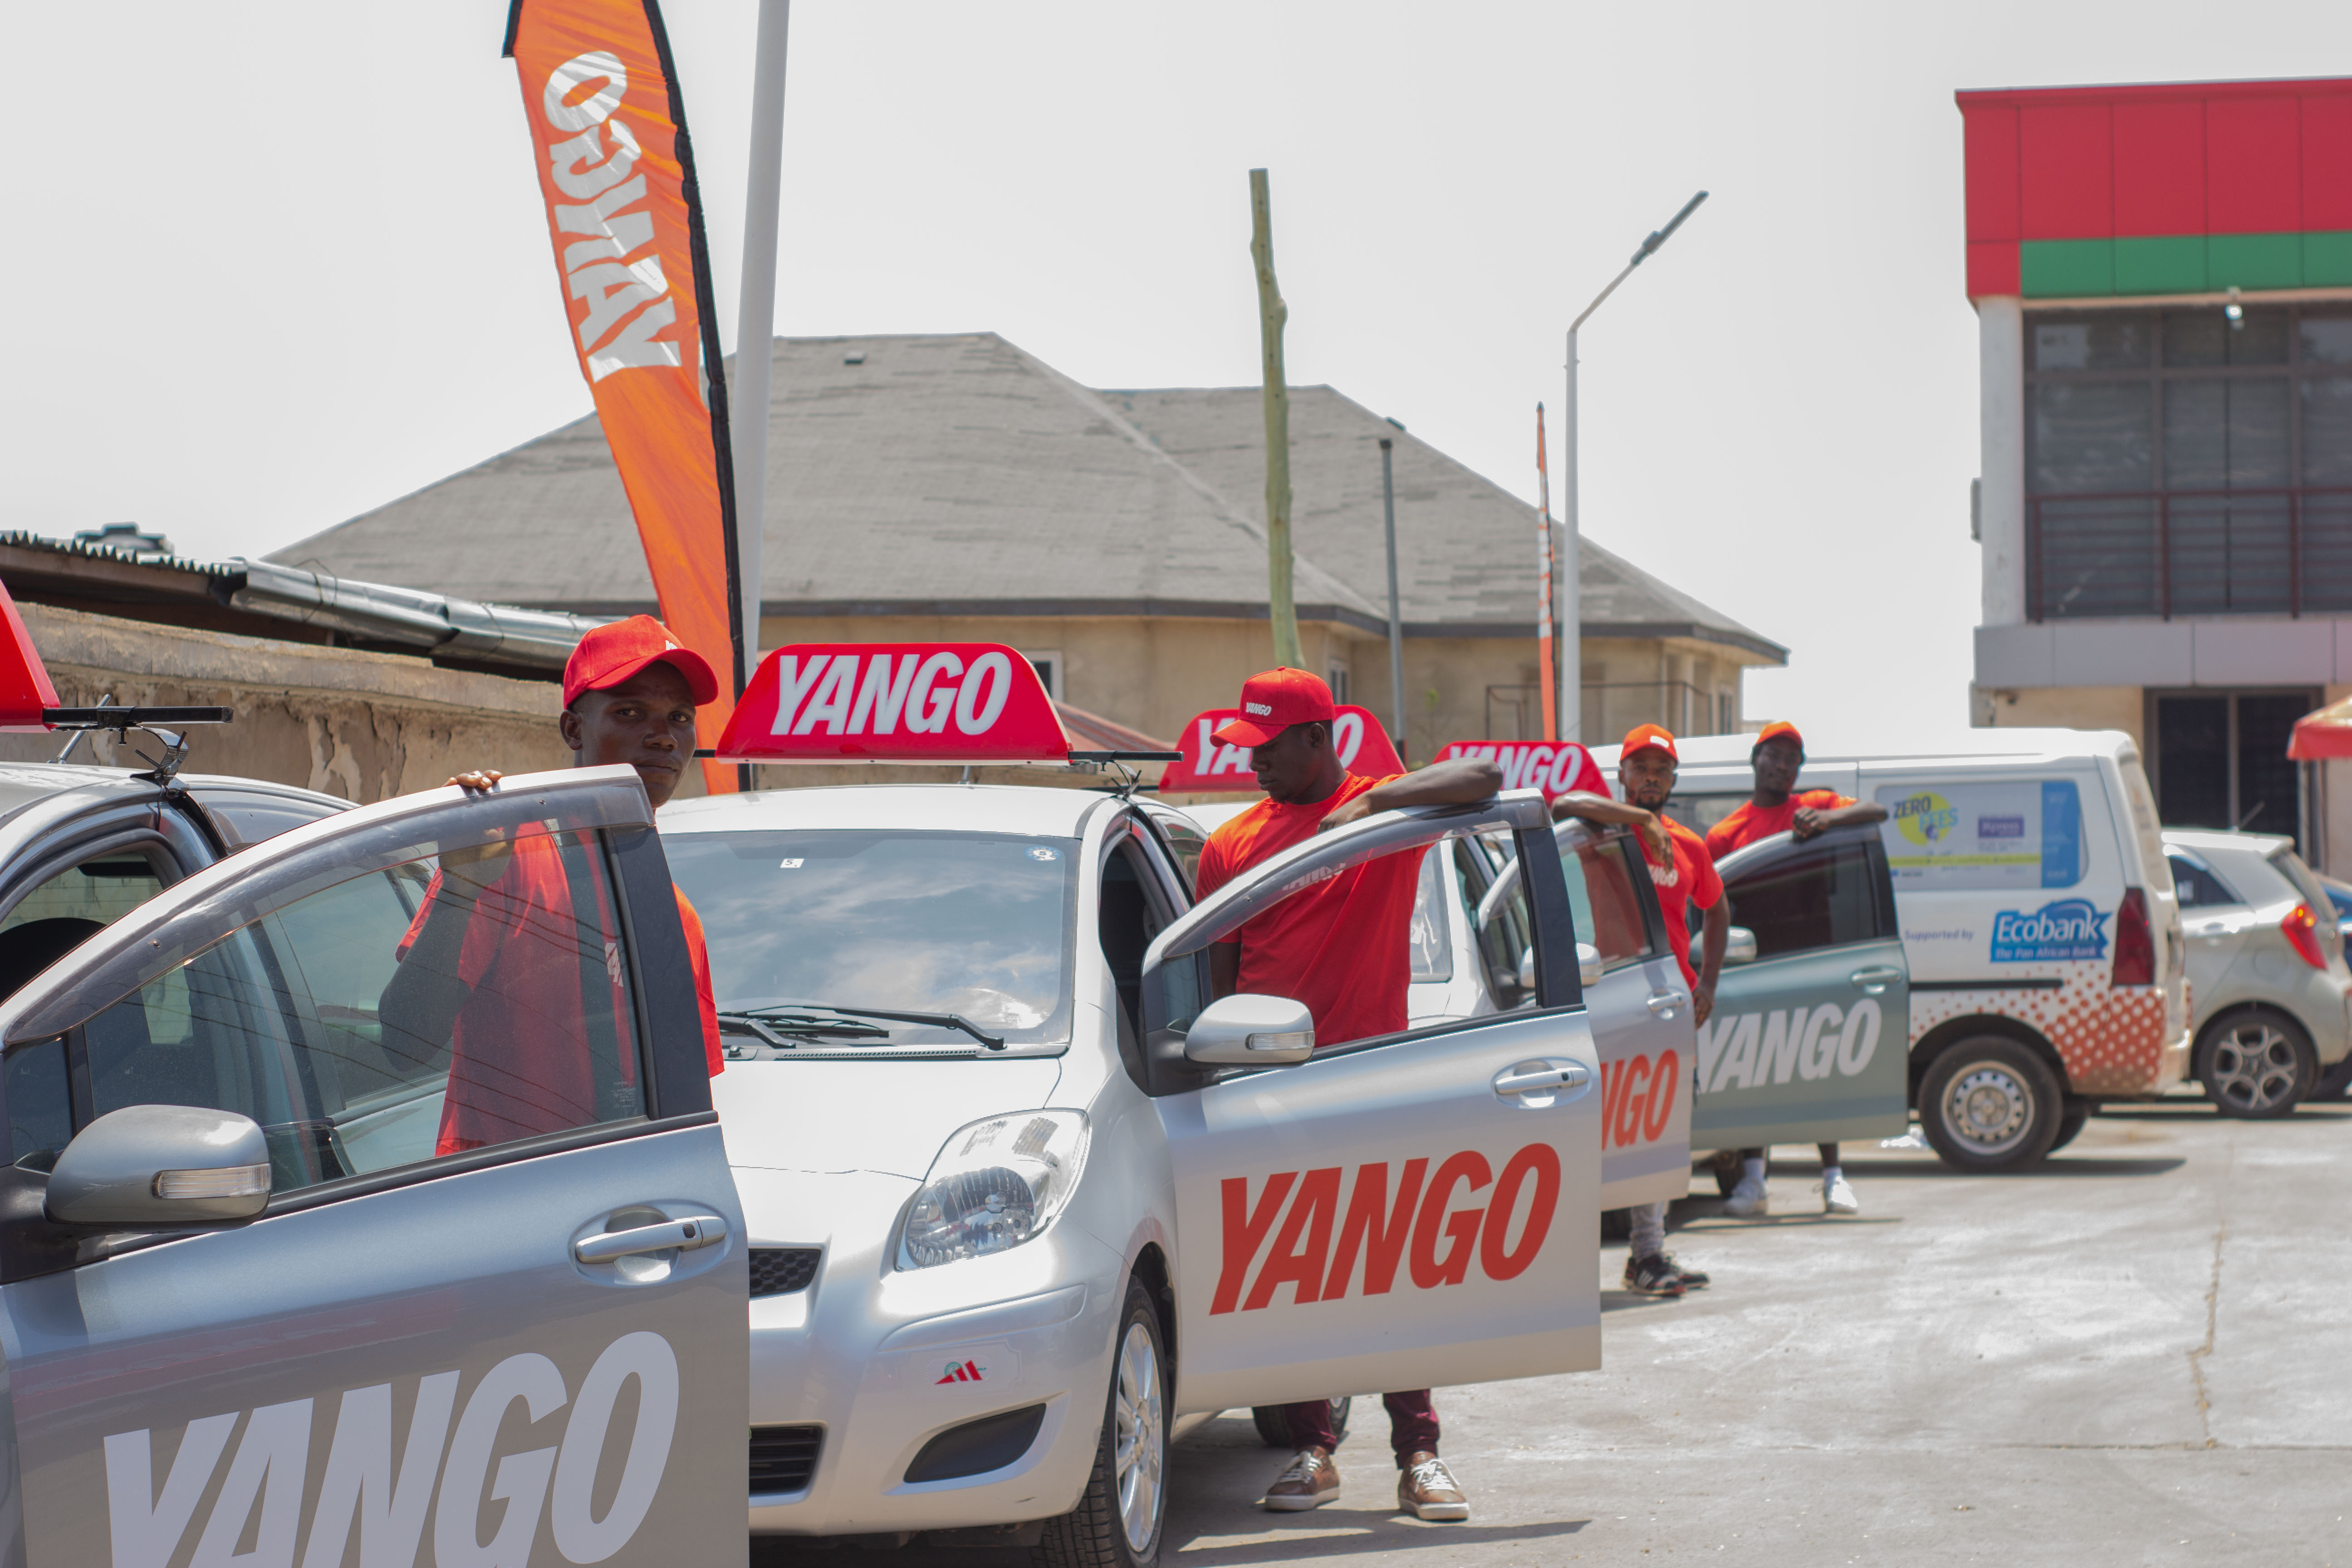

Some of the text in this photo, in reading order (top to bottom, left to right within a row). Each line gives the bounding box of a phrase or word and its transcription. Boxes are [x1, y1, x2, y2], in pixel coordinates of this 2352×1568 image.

[770, 652, 1012, 735] YANGO
[1246, 702, 1272, 716] YANGO
[1194, 713, 1364, 775] YAO
[1450, 745, 1583, 793] NGO
[1893, 796, 1931, 819] ZERO
[1919, 808, 1958, 832] FEES
[1905, 929, 1974, 942] Supported by
[1997, 913, 2099, 942] Ecobank
[1995, 945, 2097, 959] The Pan African Bank
[1697, 998, 1882, 1094] YANGO
[1209, 1143, 1561, 1316] YANGO
[104, 1331, 680, 1568] YANGO
